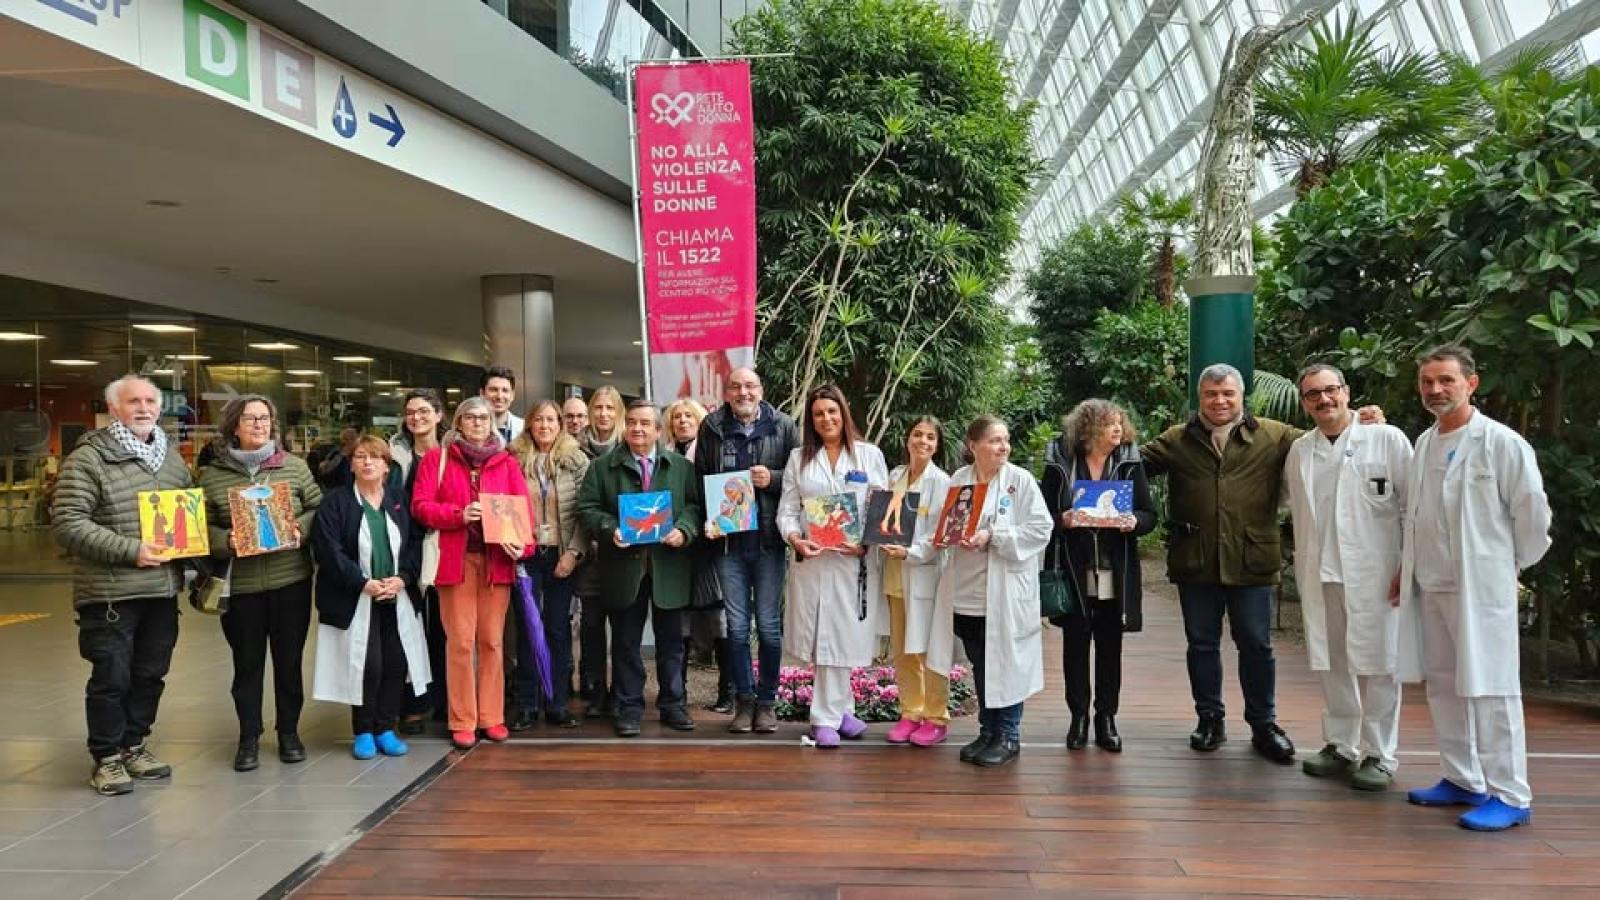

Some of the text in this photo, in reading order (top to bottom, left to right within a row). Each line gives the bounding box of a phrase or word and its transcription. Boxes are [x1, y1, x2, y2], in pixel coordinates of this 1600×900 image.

[200, 14, 303, 110] D E
[651, 142, 729, 159] NO ALLA
[652, 159, 742, 177] VIOLENZA
[652, 179, 708, 195] SULLE
[654, 196, 717, 213] DONNE
[656, 226, 734, 246] CHIAMA
[657, 247, 722, 266] IL 1522
